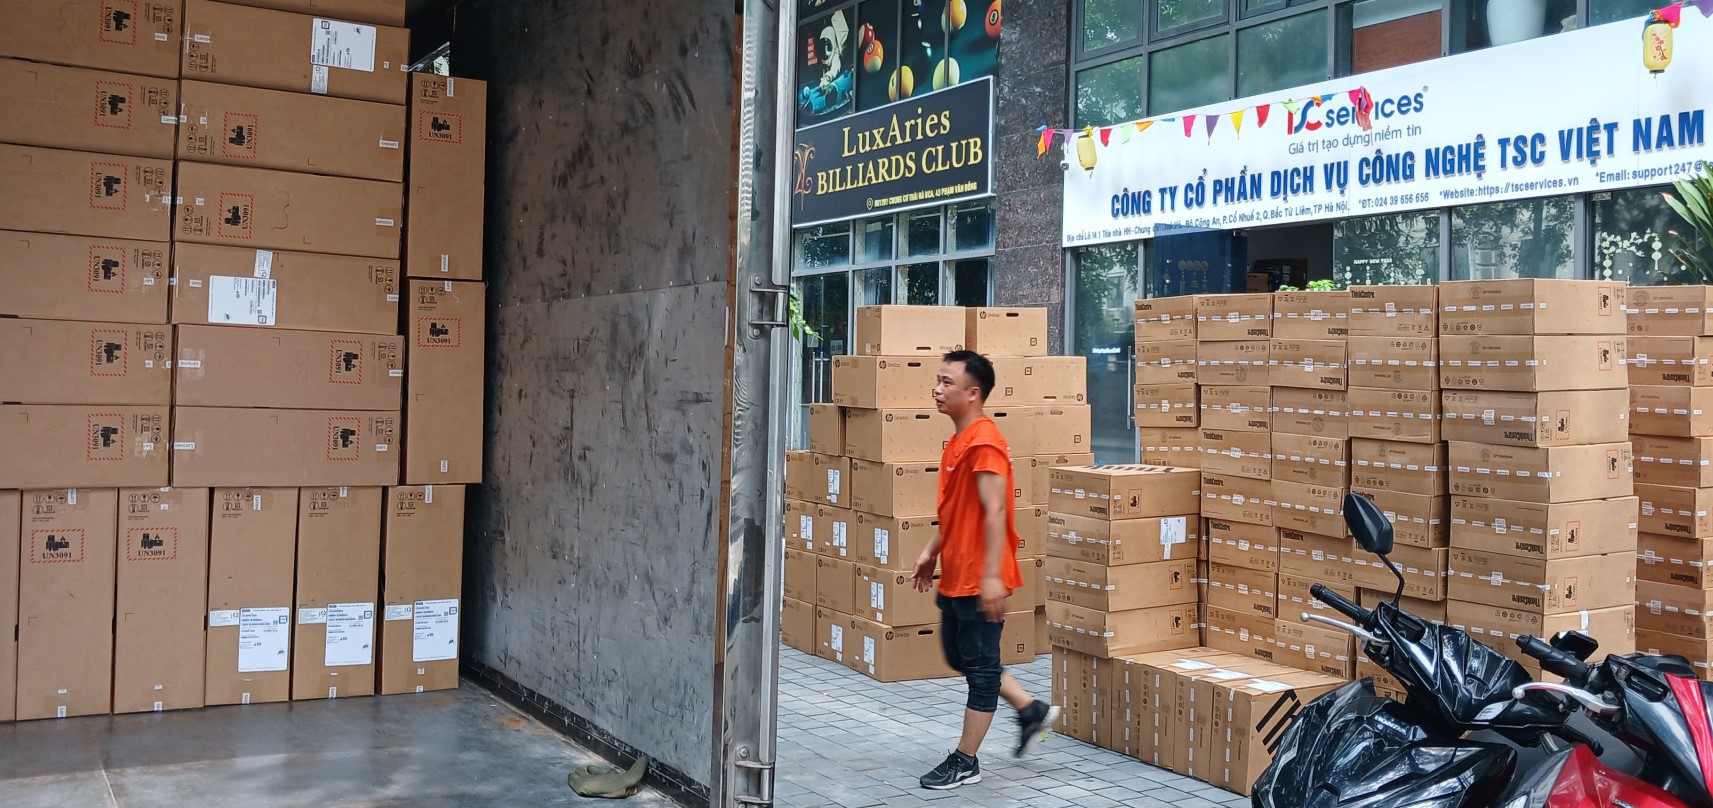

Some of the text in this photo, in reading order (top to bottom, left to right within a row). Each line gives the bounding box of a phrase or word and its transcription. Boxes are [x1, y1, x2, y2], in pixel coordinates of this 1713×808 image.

[104, 6, 112, 32] UN3091
[99, 91, 108, 117] UN3091
[1325, 92, 1424, 128] serices
[842, 107, 950, 157] LuxAries
[1289, 124, 1422, 155] Giá trị tạo dựng niềm tin
[816, 137, 983, 195] BILLIARDS CLUB
[1111, 109, 1705, 219] CÔNG TY CỔ PHẦN DỊCH VỤ CÔNG NGHỆ TSC VIỆT NAM
[94, 172, 103, 198] UN3091
[1325, 203, 1334, 212] Hà
[1390, 196, 1397, 206] 39
[1400, 194, 1413, 205] 656
[1416, 193, 1429, 203] 656
[92, 256, 100, 282] UN3091
[95, 339, 103, 366] UN3091
